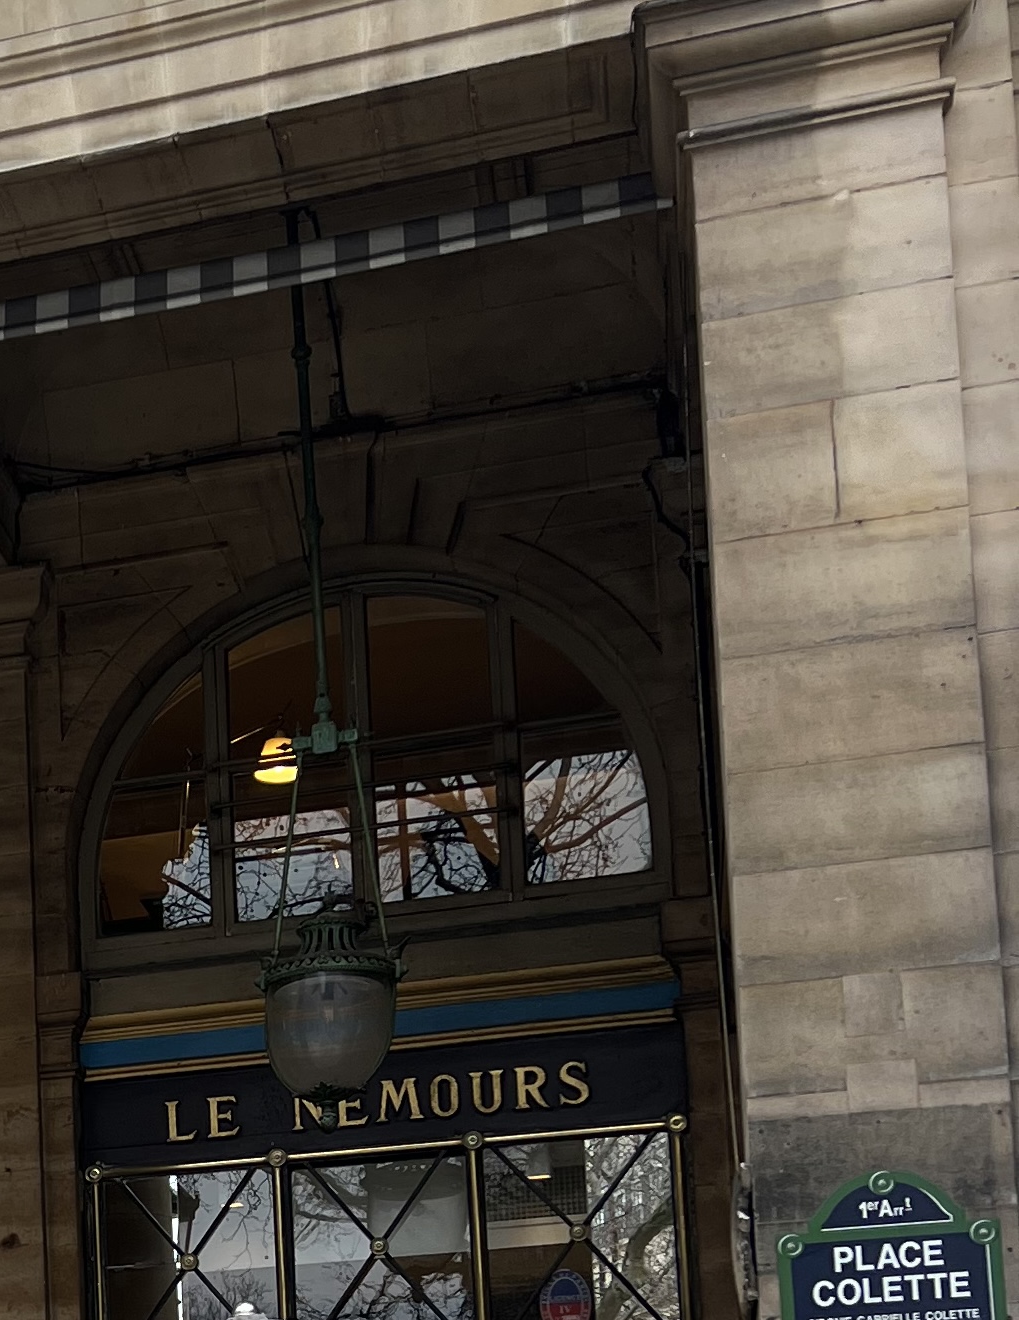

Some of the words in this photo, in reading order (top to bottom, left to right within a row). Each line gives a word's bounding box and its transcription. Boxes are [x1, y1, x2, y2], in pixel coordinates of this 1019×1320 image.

[164, 1095, 241, 1143] LE
[291, 1060, 591, 1133] NEMOURS
[832, 1239, 945, 1273] PLACE
[811, 1270, 972, 1307] COLETTE
